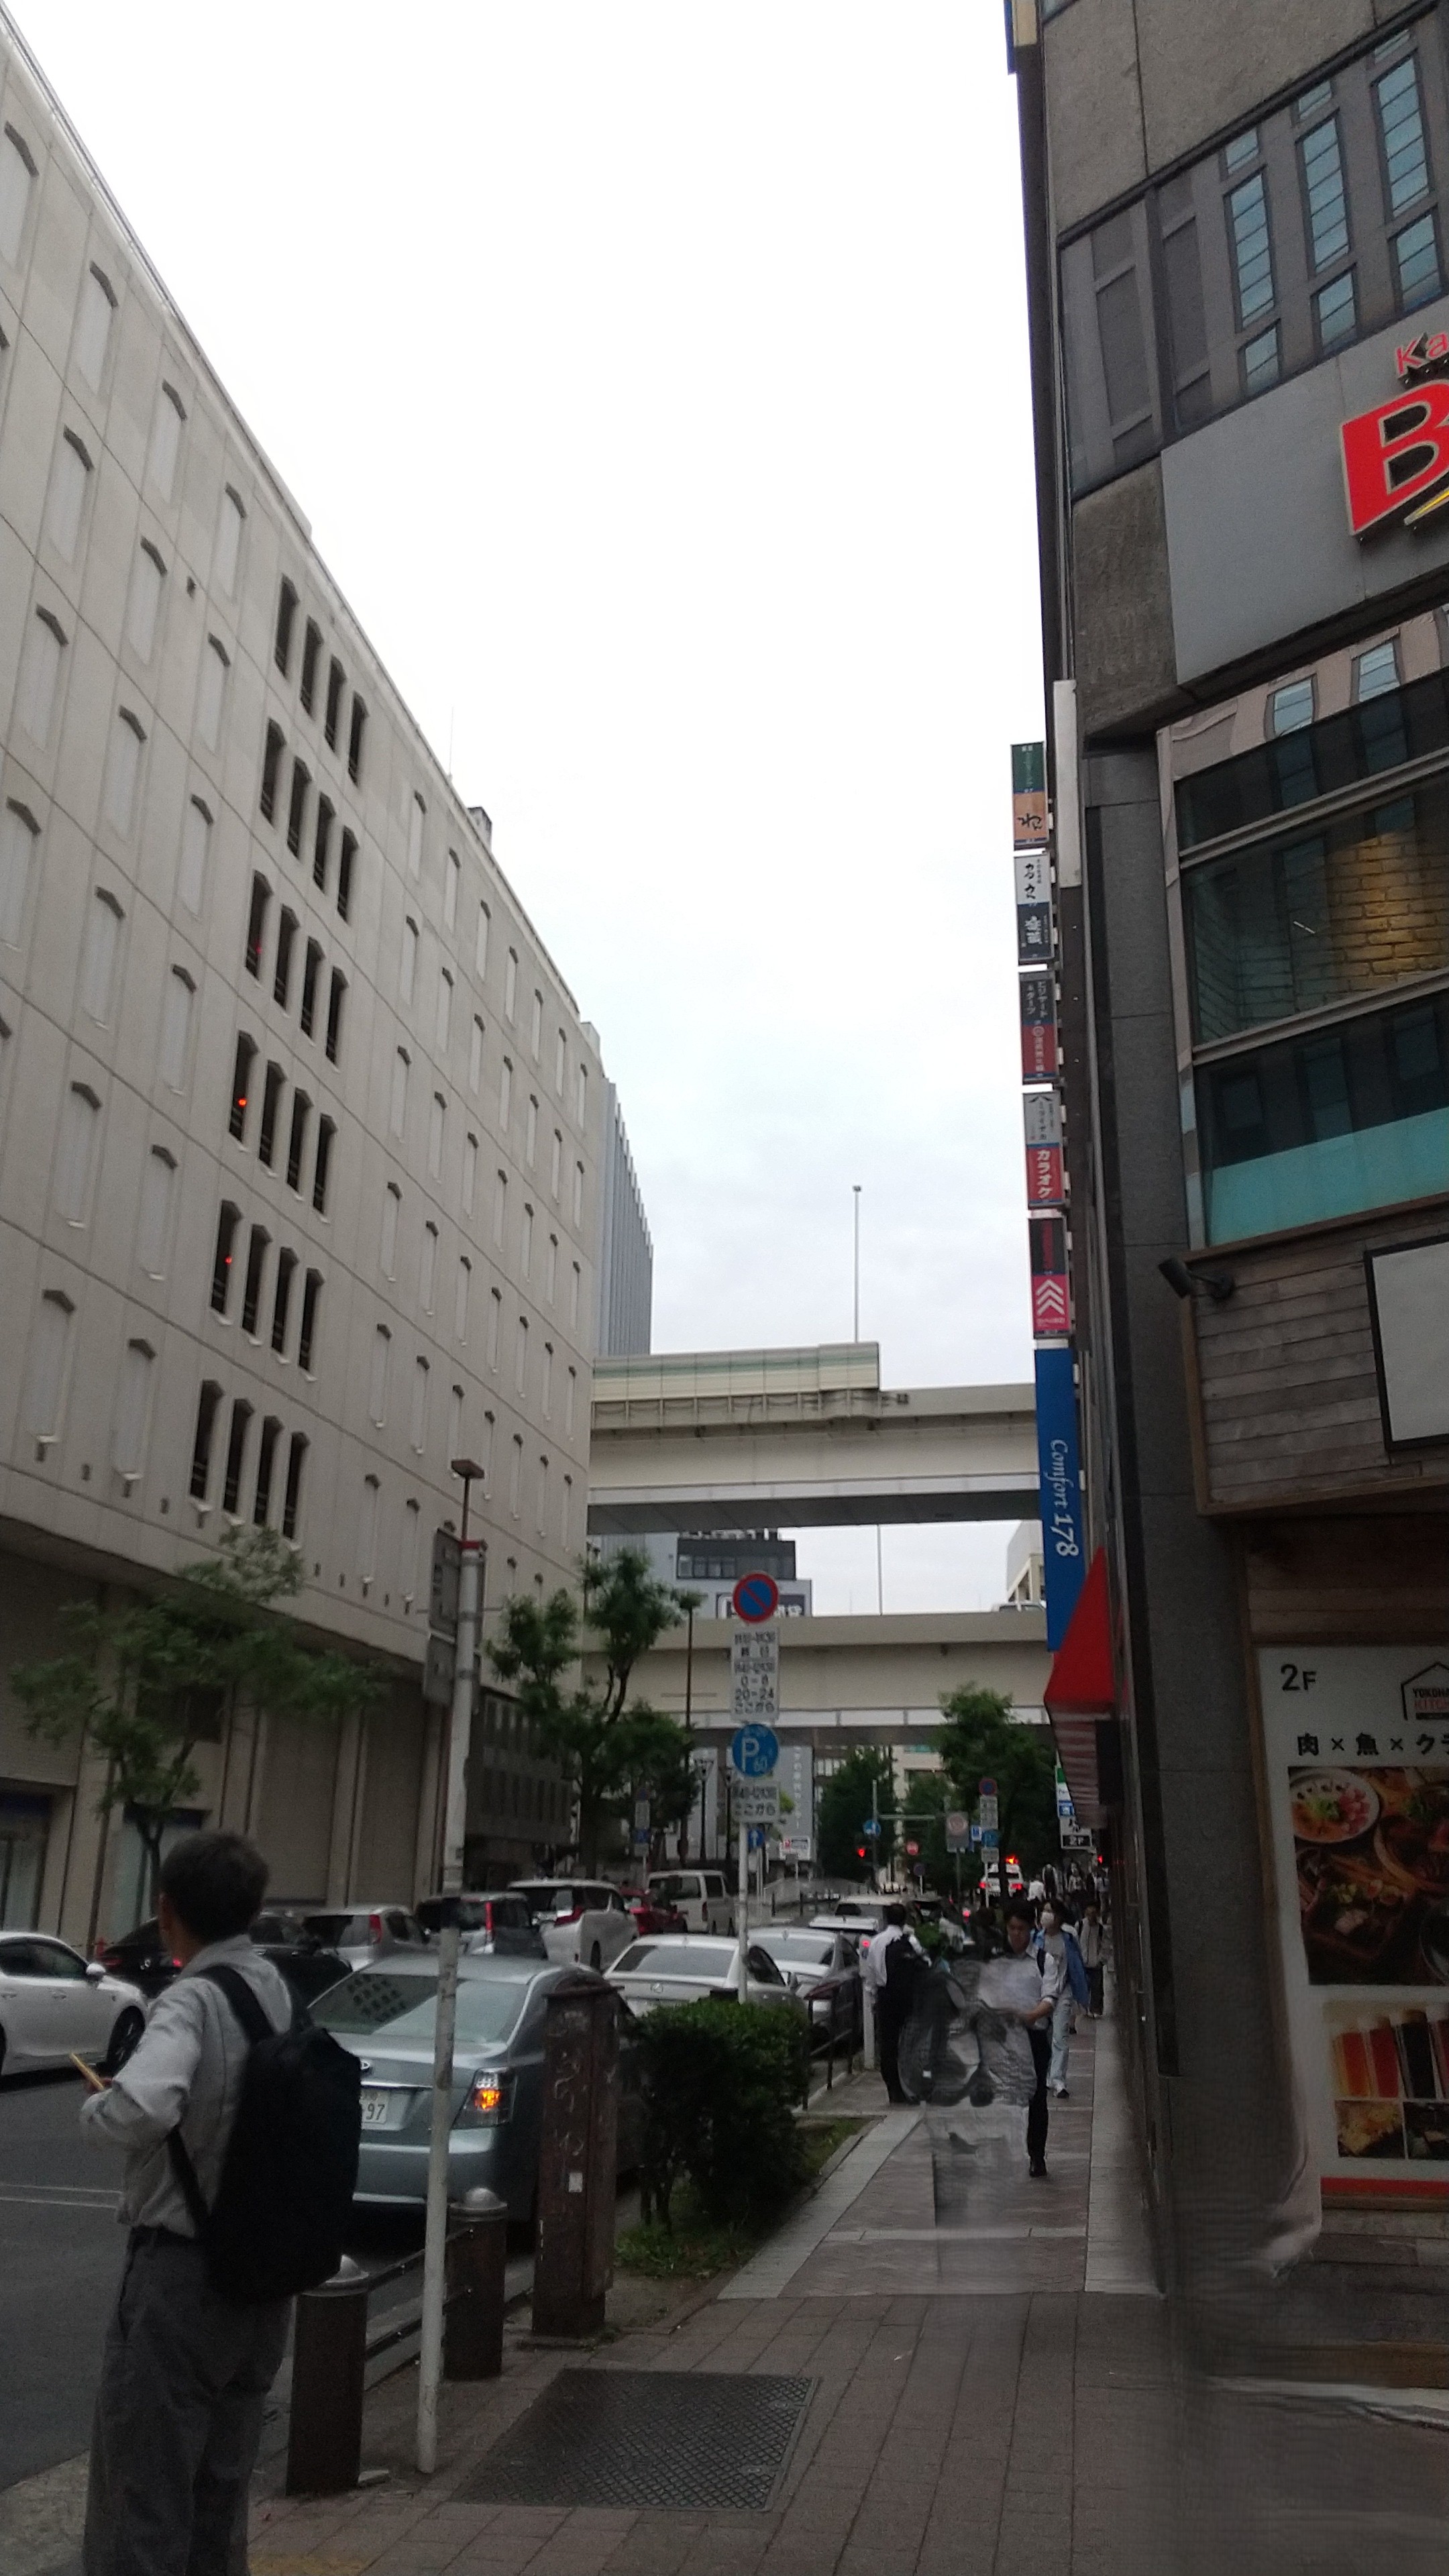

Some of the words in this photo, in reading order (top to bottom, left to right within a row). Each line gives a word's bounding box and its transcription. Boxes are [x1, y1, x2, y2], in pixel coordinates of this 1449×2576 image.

[1036, 1149, 1054, 1199] カラオケ
[1044, 1439, 1074, 1509] Comfort
[1050, 1513, 1079, 1557] 178
[1281, 1664, 1317, 1690] 2F
[741, 1737, 759, 1772] P
